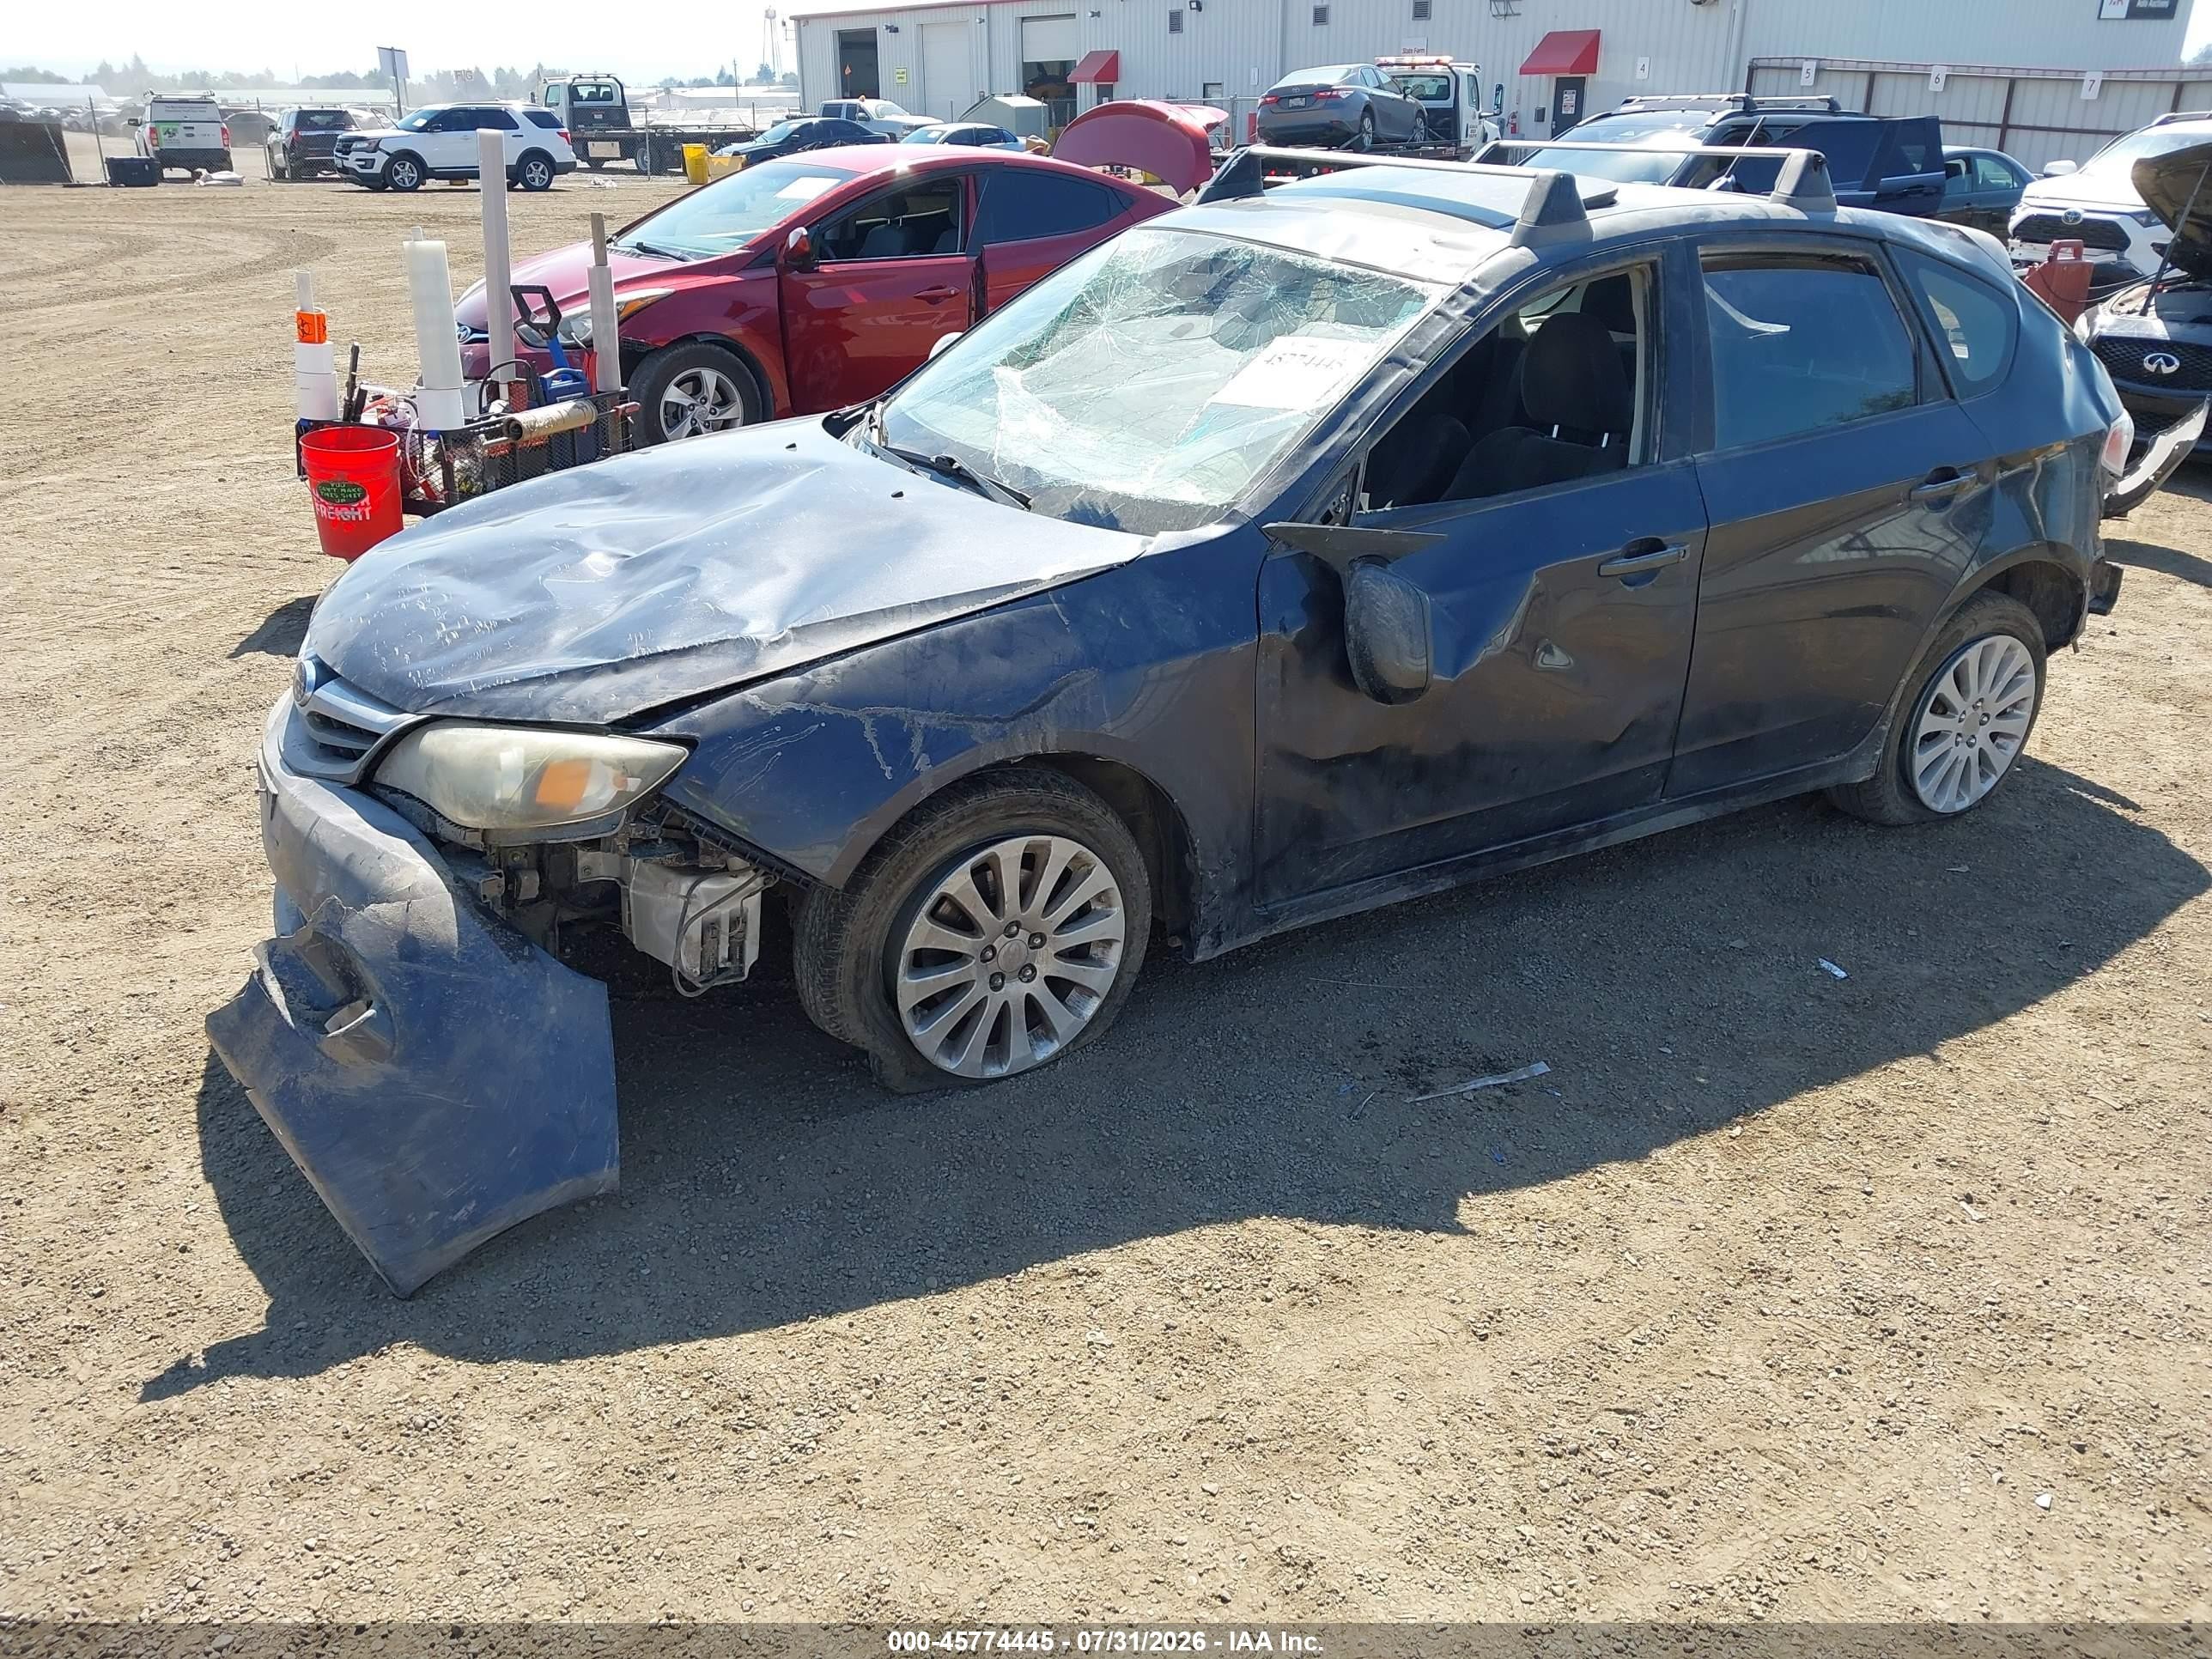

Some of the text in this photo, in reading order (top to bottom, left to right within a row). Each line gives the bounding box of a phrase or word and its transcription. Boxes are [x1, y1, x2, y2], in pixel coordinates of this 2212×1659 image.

[1640, 64, 1645, 73] 4
[1805, 68, 1811, 79] 5
[1935, 73, 1941, 84] 6
[2088, 79, 2096, 91] 7
[314, 501, 373, 521] FREIGHT
